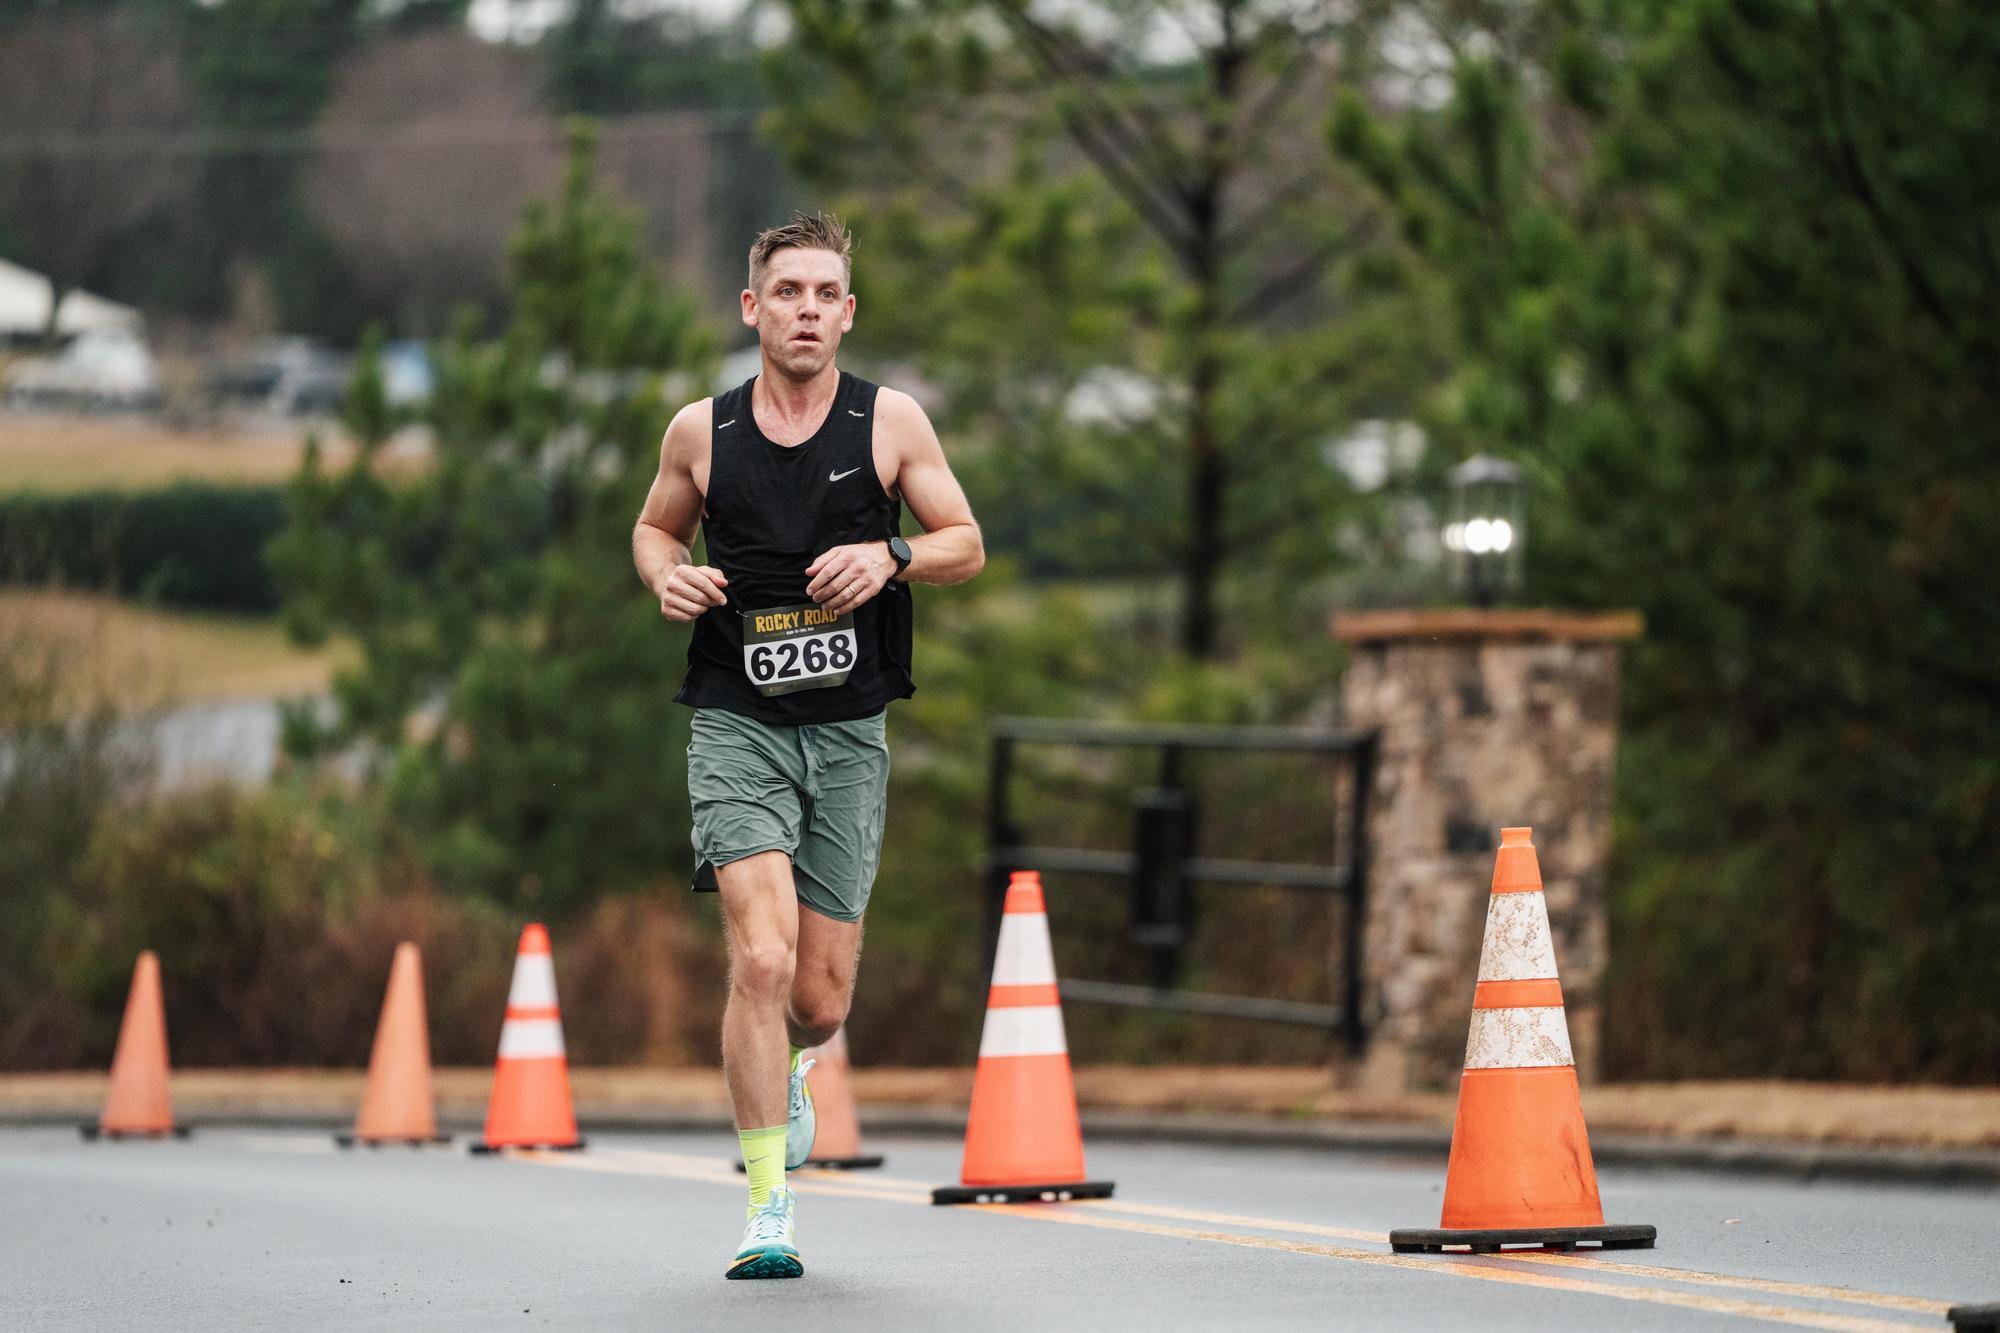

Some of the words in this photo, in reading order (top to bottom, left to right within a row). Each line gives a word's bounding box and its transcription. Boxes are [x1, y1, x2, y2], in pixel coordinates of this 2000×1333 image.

[755, 611, 800, 633] ROCKY
[804, 609, 838, 626] ROAD
[750, 634, 853, 681] 6268
